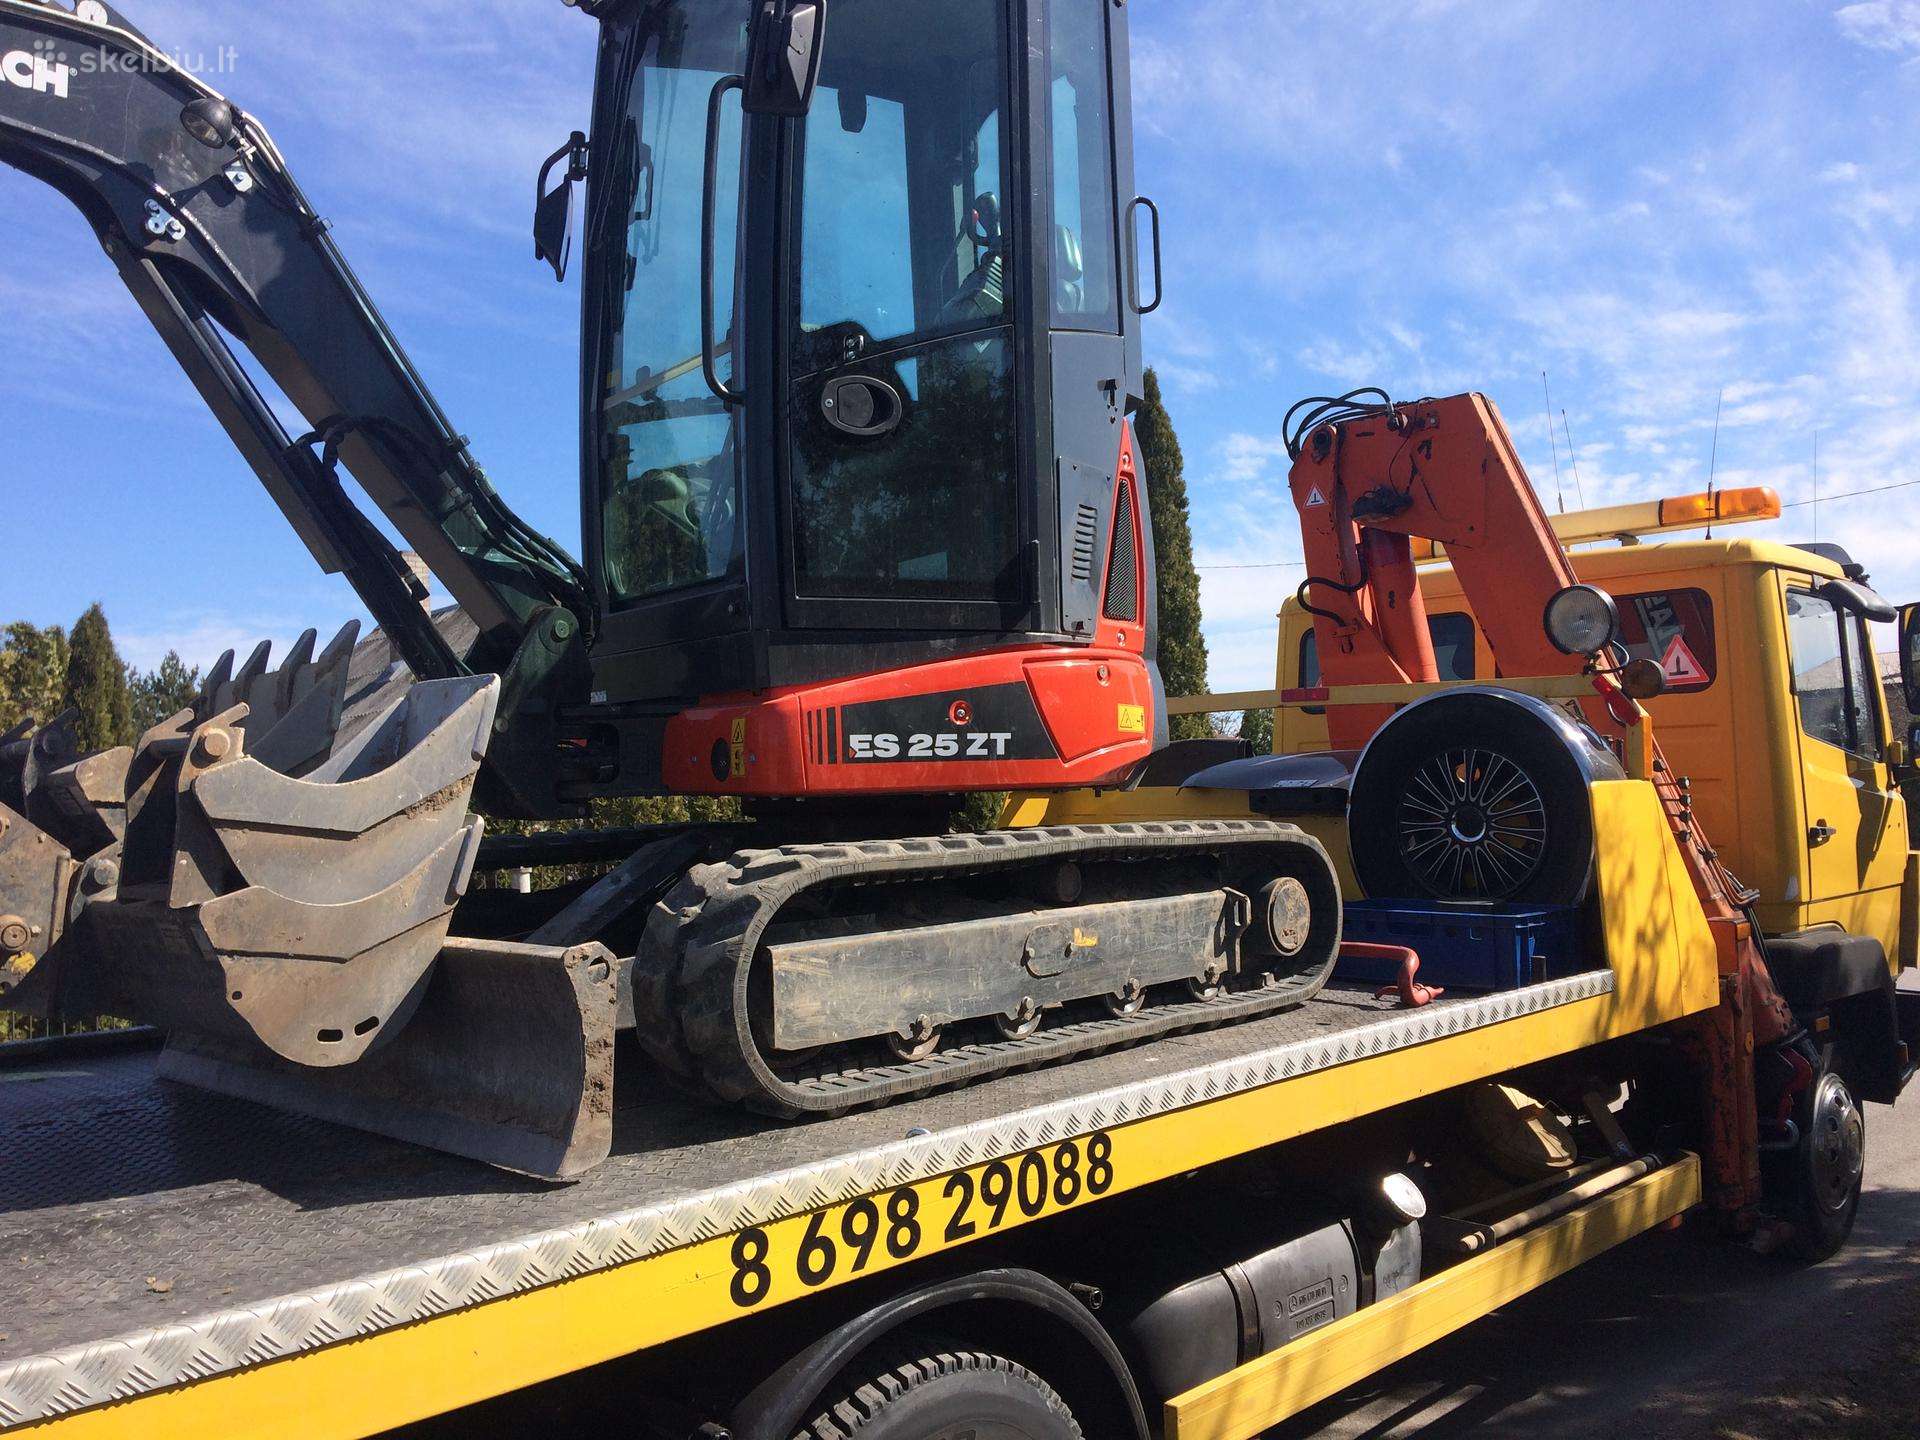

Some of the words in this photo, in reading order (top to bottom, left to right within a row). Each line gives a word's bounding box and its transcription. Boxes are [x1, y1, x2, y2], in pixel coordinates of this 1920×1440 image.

[849, 733, 900, 758] ES
[907, 733, 959, 757] 25
[966, 732, 1012, 756] ZT
[729, 1228, 772, 1308] 8
[796, 1187, 922, 1287] 698
[942, 1132, 1114, 1244] 29088
